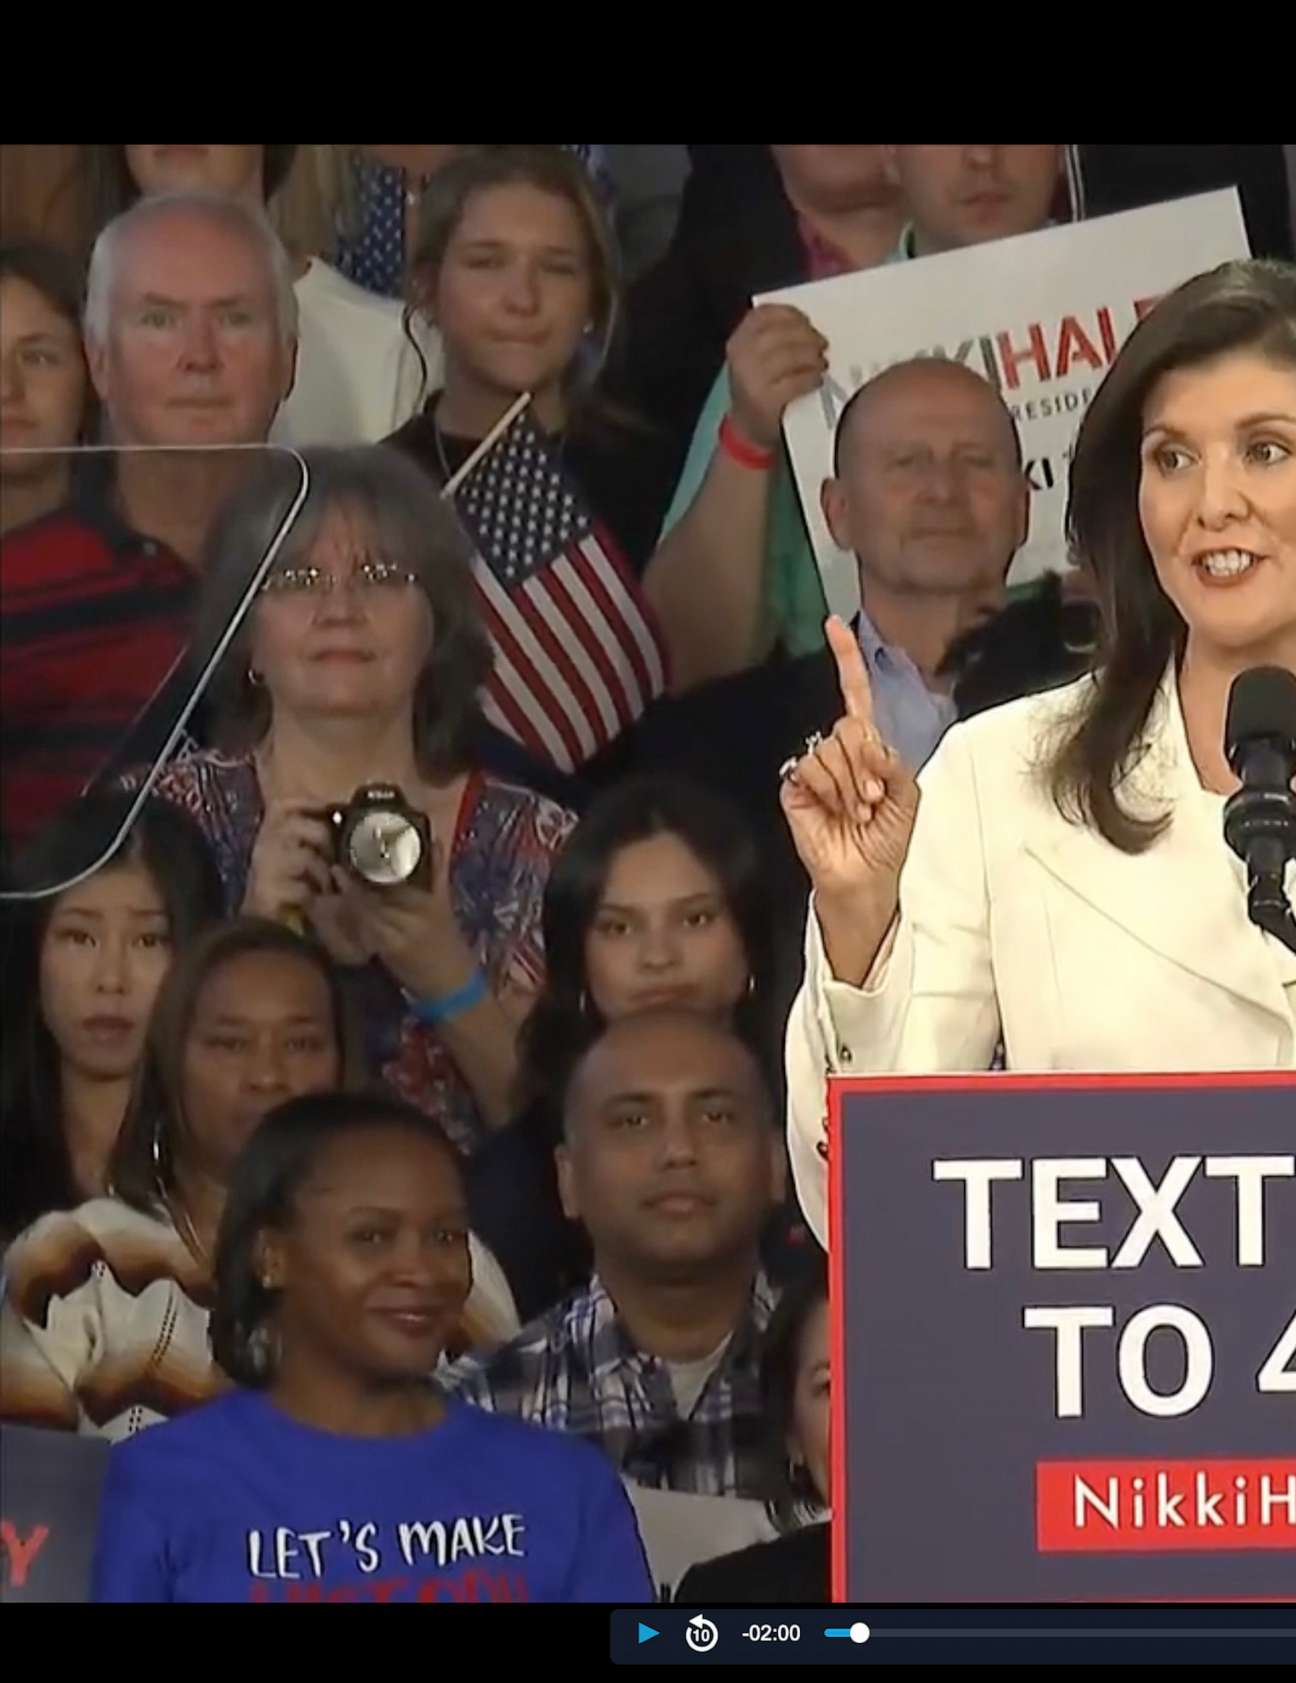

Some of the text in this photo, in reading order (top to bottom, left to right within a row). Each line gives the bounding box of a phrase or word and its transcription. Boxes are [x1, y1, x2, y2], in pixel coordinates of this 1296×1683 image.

[932, 1154, 1296, 1270] TEXT
[1022, 1301, 1216, 1419] TO
[249, 1513, 526, 1579] LET'S MAKE
